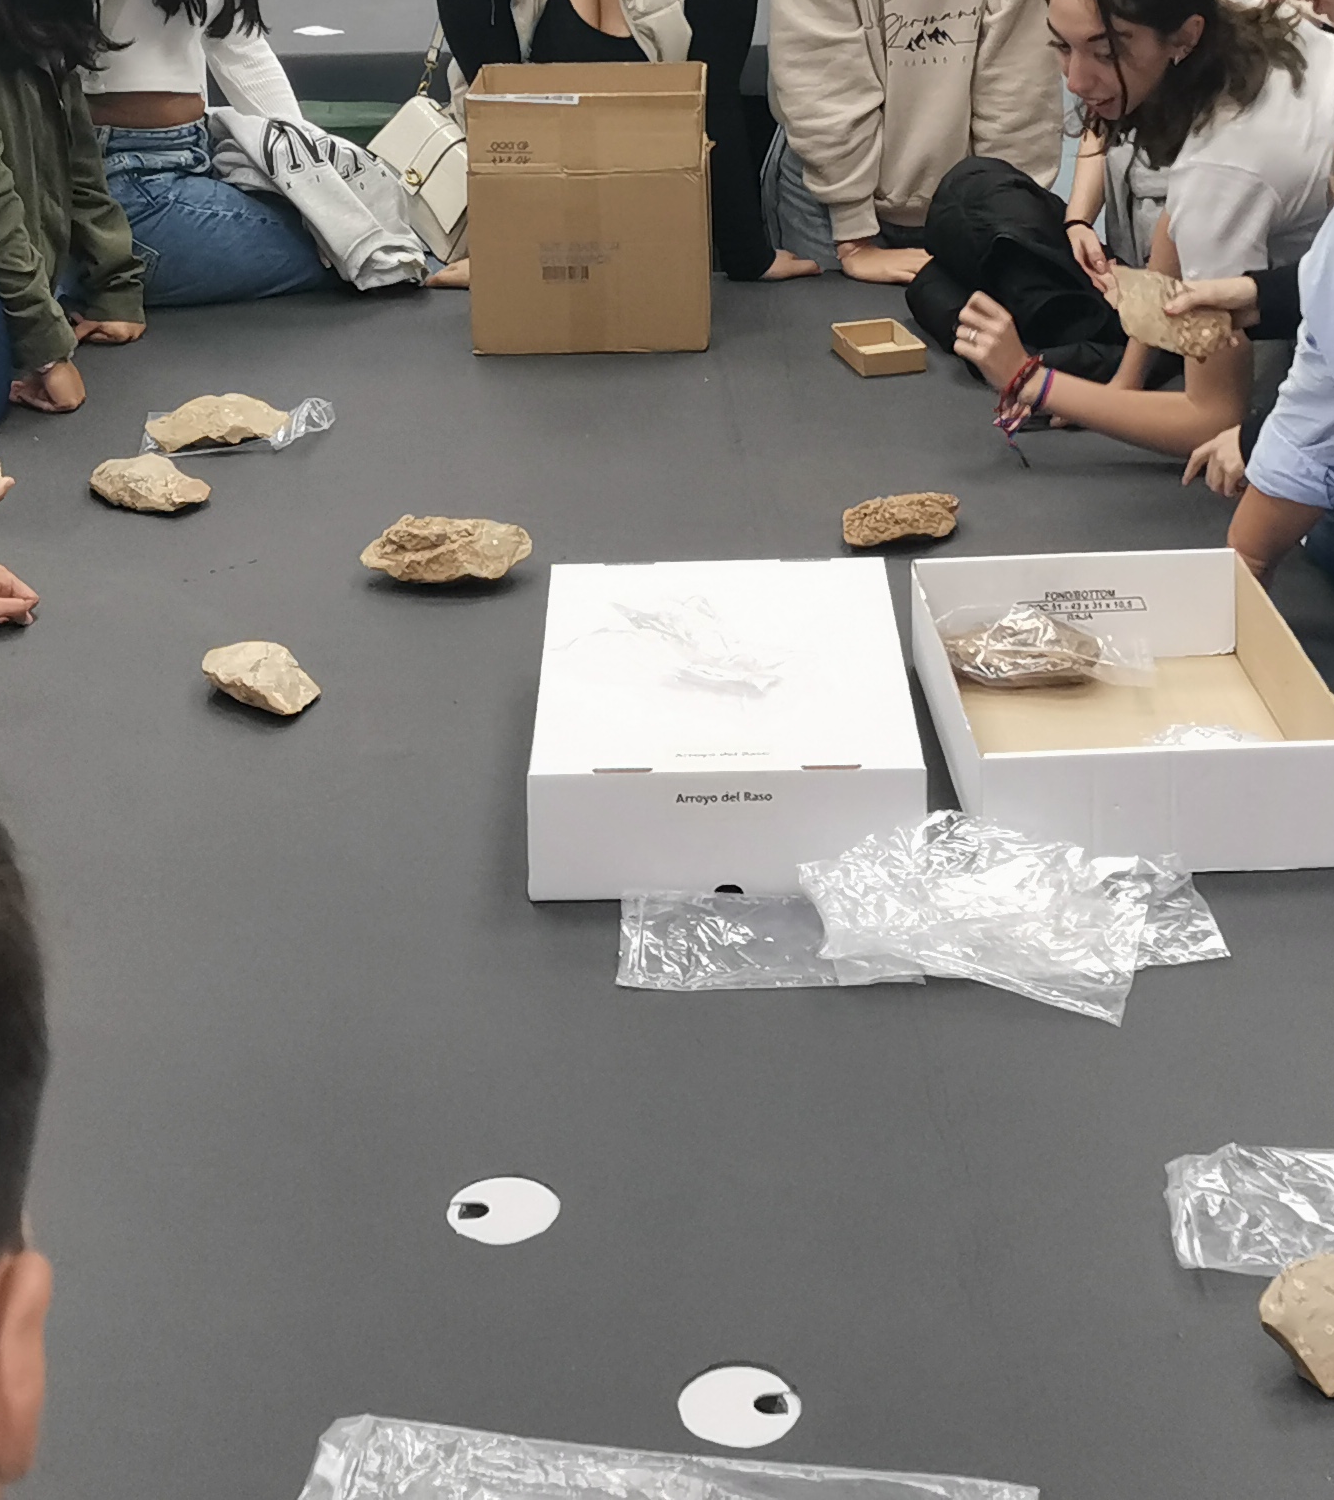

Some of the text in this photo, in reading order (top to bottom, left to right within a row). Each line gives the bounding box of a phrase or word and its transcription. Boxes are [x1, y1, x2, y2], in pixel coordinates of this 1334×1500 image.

[676, 791, 773, 806] Arroyo del Raso
